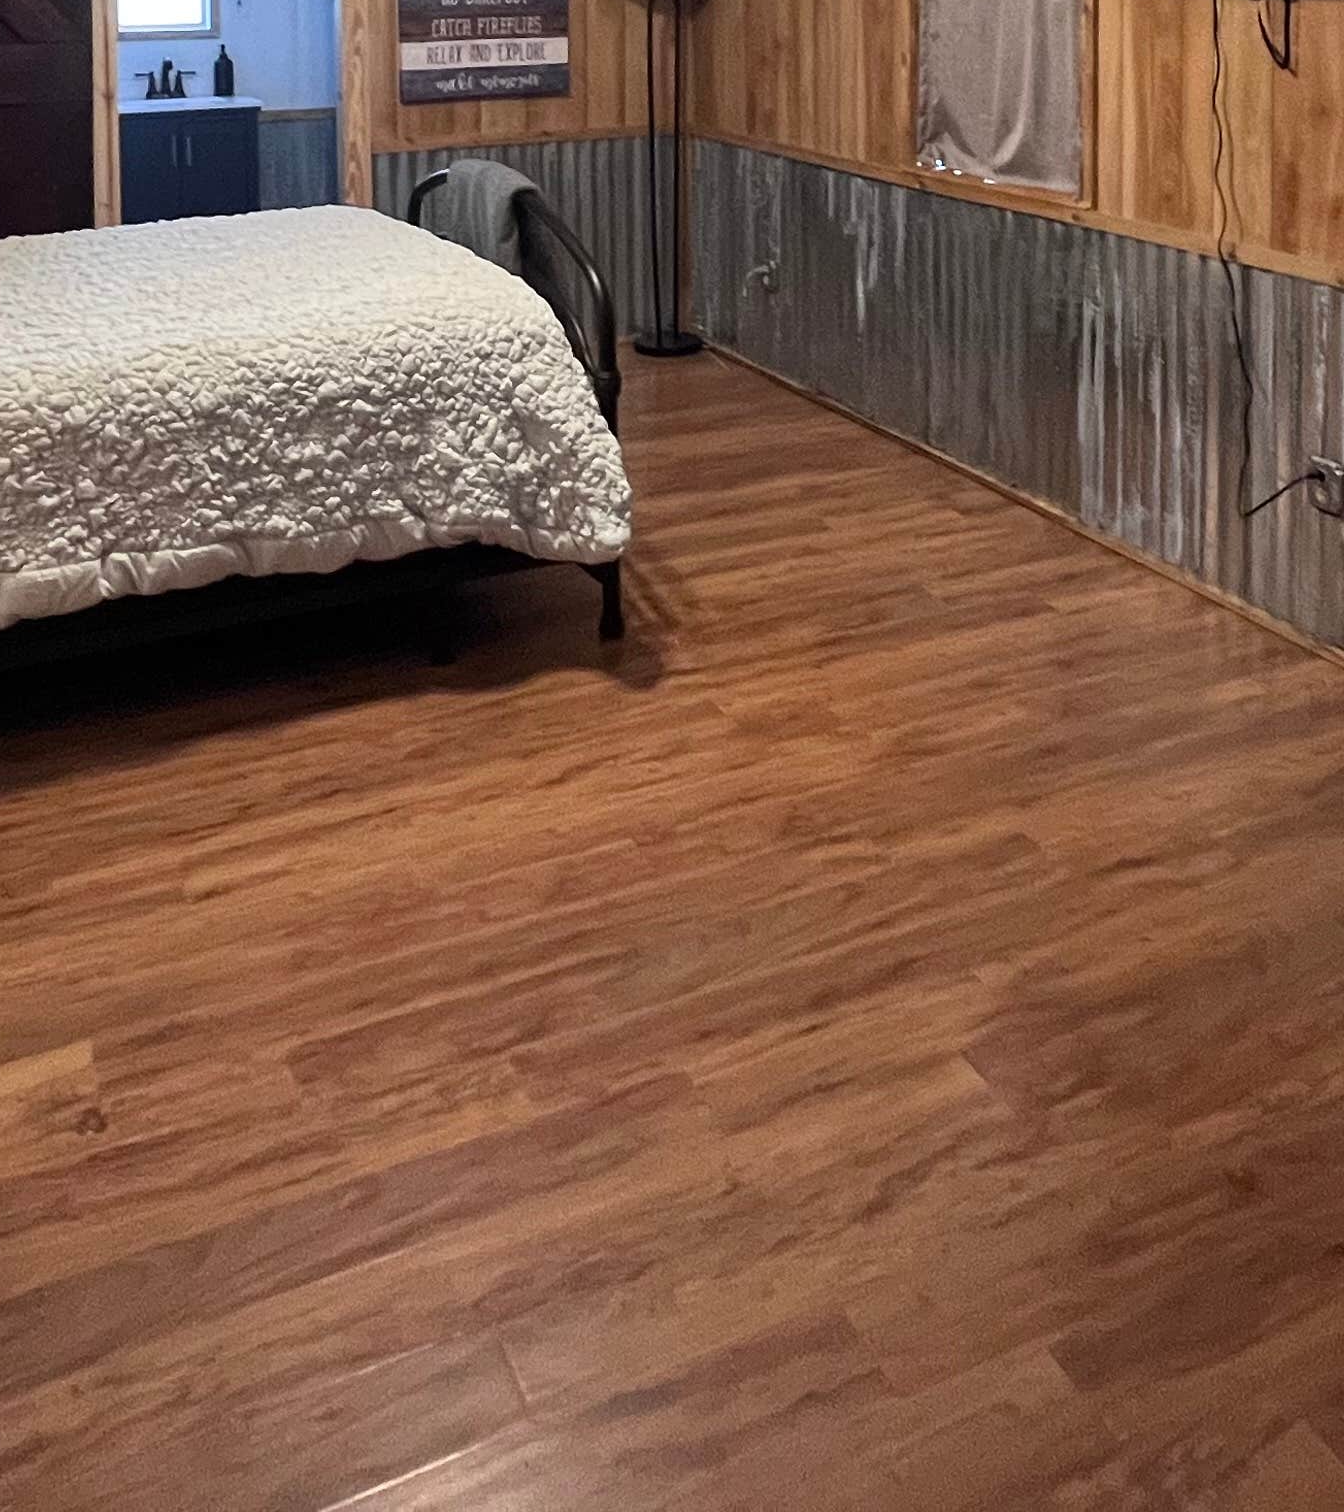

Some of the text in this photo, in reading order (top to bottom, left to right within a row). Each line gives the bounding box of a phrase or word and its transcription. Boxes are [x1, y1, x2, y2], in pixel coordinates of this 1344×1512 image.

[431, 16, 543, 37] CATCH FIREFLIES
[426, 42, 547, 65] RELAX AND EXPLORE
